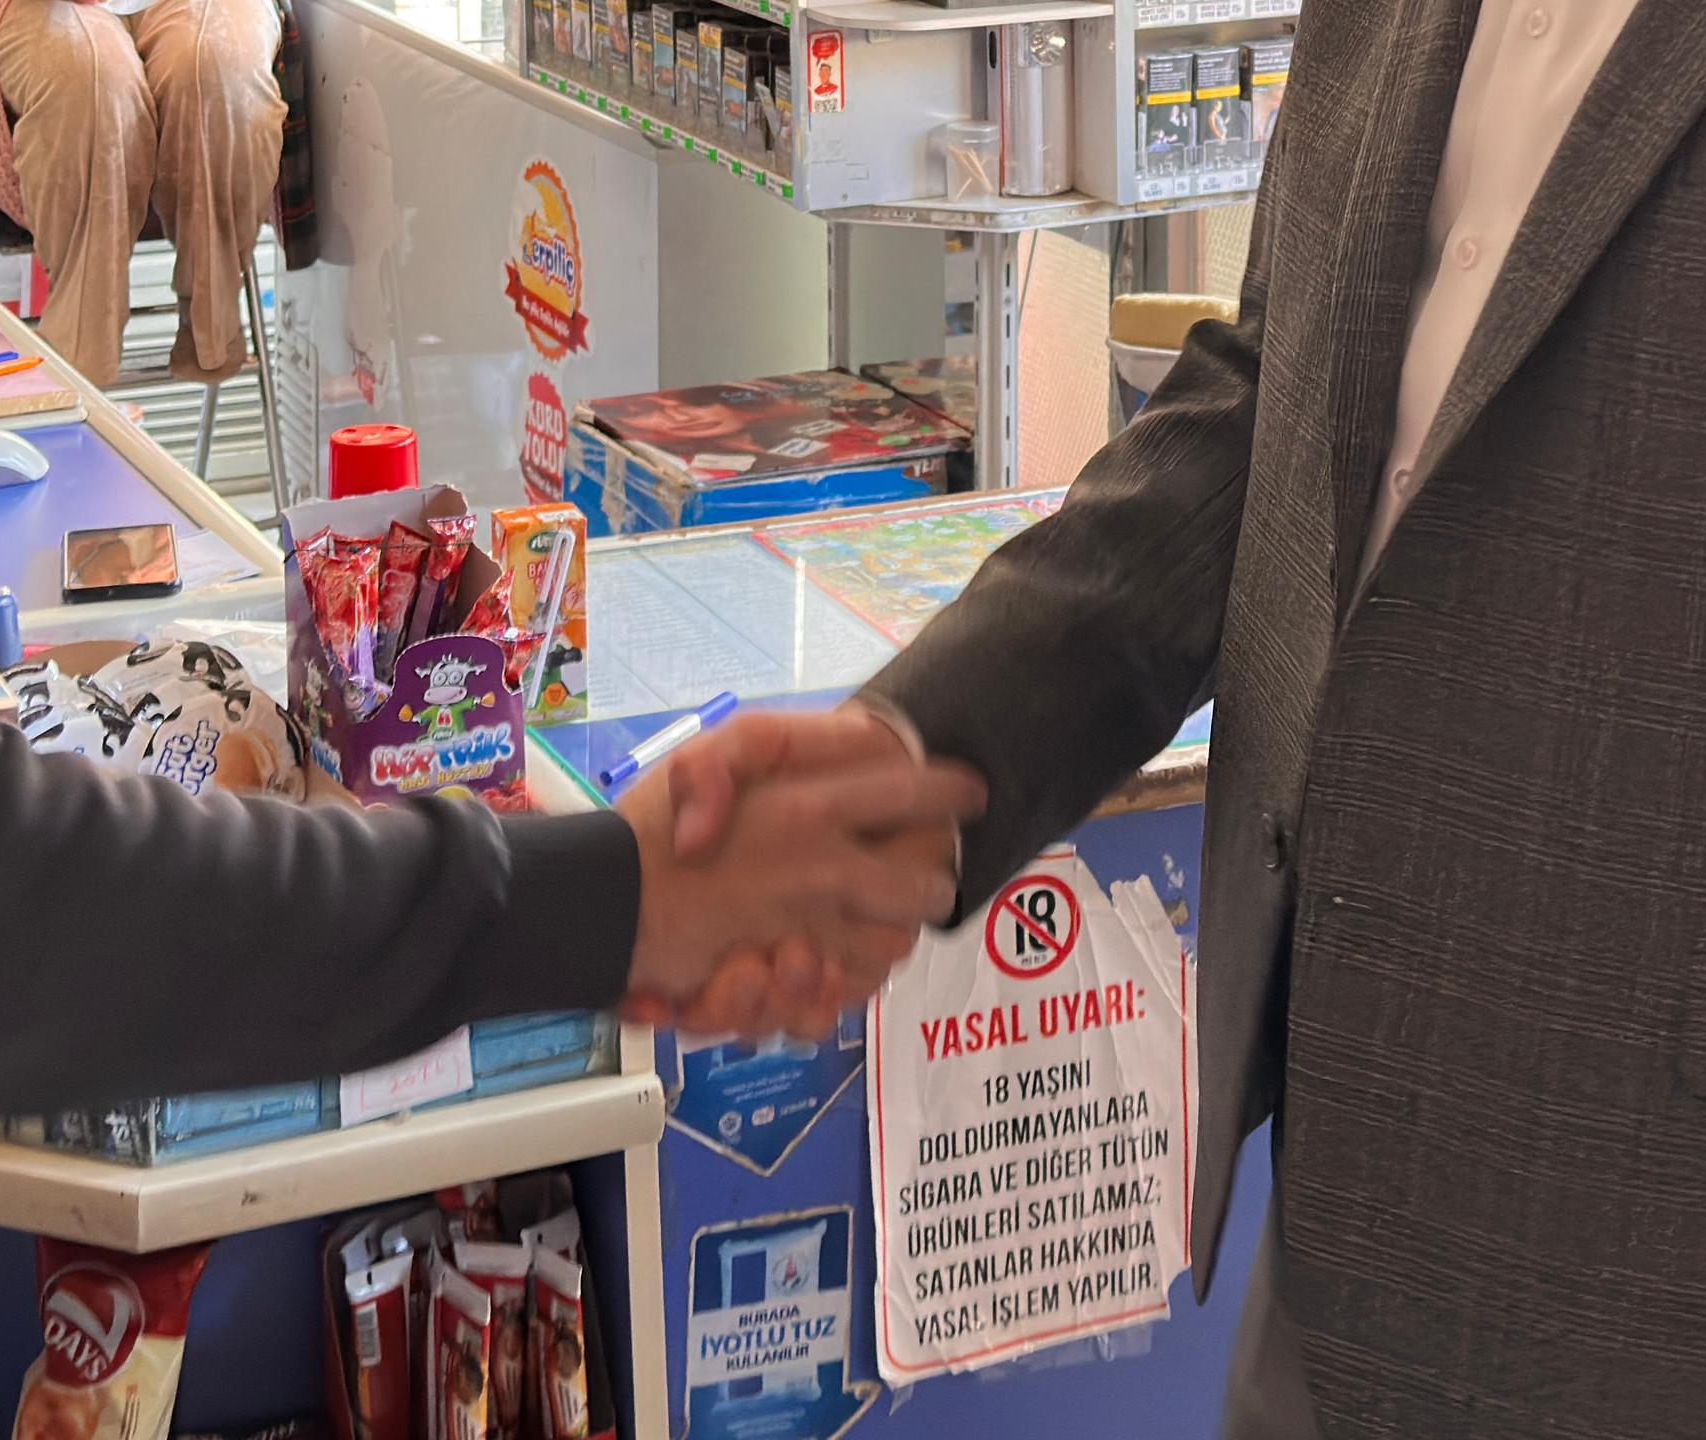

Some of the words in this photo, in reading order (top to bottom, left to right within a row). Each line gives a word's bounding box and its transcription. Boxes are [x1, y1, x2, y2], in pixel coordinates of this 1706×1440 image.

[181, 719, 220, 797] urger
[1014, 888, 1058, 957] 18
[920, 1003, 1030, 1063] YASAL
[1039, 979, 1146, 1039] UYARI:
[983, 1075, 1010, 1109] 18
[1016, 1058, 1092, 1102] YAŞINI
[919, 1090, 1150, 1167] DOLDURMAYANLARA
[899, 1169, 983, 1216] SİGARA
[990, 1161, 1019, 1195] VE
[1026, 1146, 1092, 1188] DİĞER
[1098, 1128, 1169, 1171] TÜTÜN
[908, 1205, 1021, 1260] ÜRÜNLERİ
[1028, 1173, 1163, 1231] SATILAMAZ;
[915, 1247, 1033, 1303] SATANLAR
[1041, 1219, 1156, 1271] HAKKINDA
[700, 1322, 786, 1361] İYOTLU
[793, 1314, 838, 1342] TUZ
[738, 1303, 801, 1329] BURADA
[915, 1303, 983, 1348] YASAL
[993, 1282, 1060, 1328] İŞLEM
[1068, 1262, 1159, 1308] YAPILIR.
[44, 1314, 109, 1381] DAYS
[726, 1343, 810, 1373] KULLANILIR
